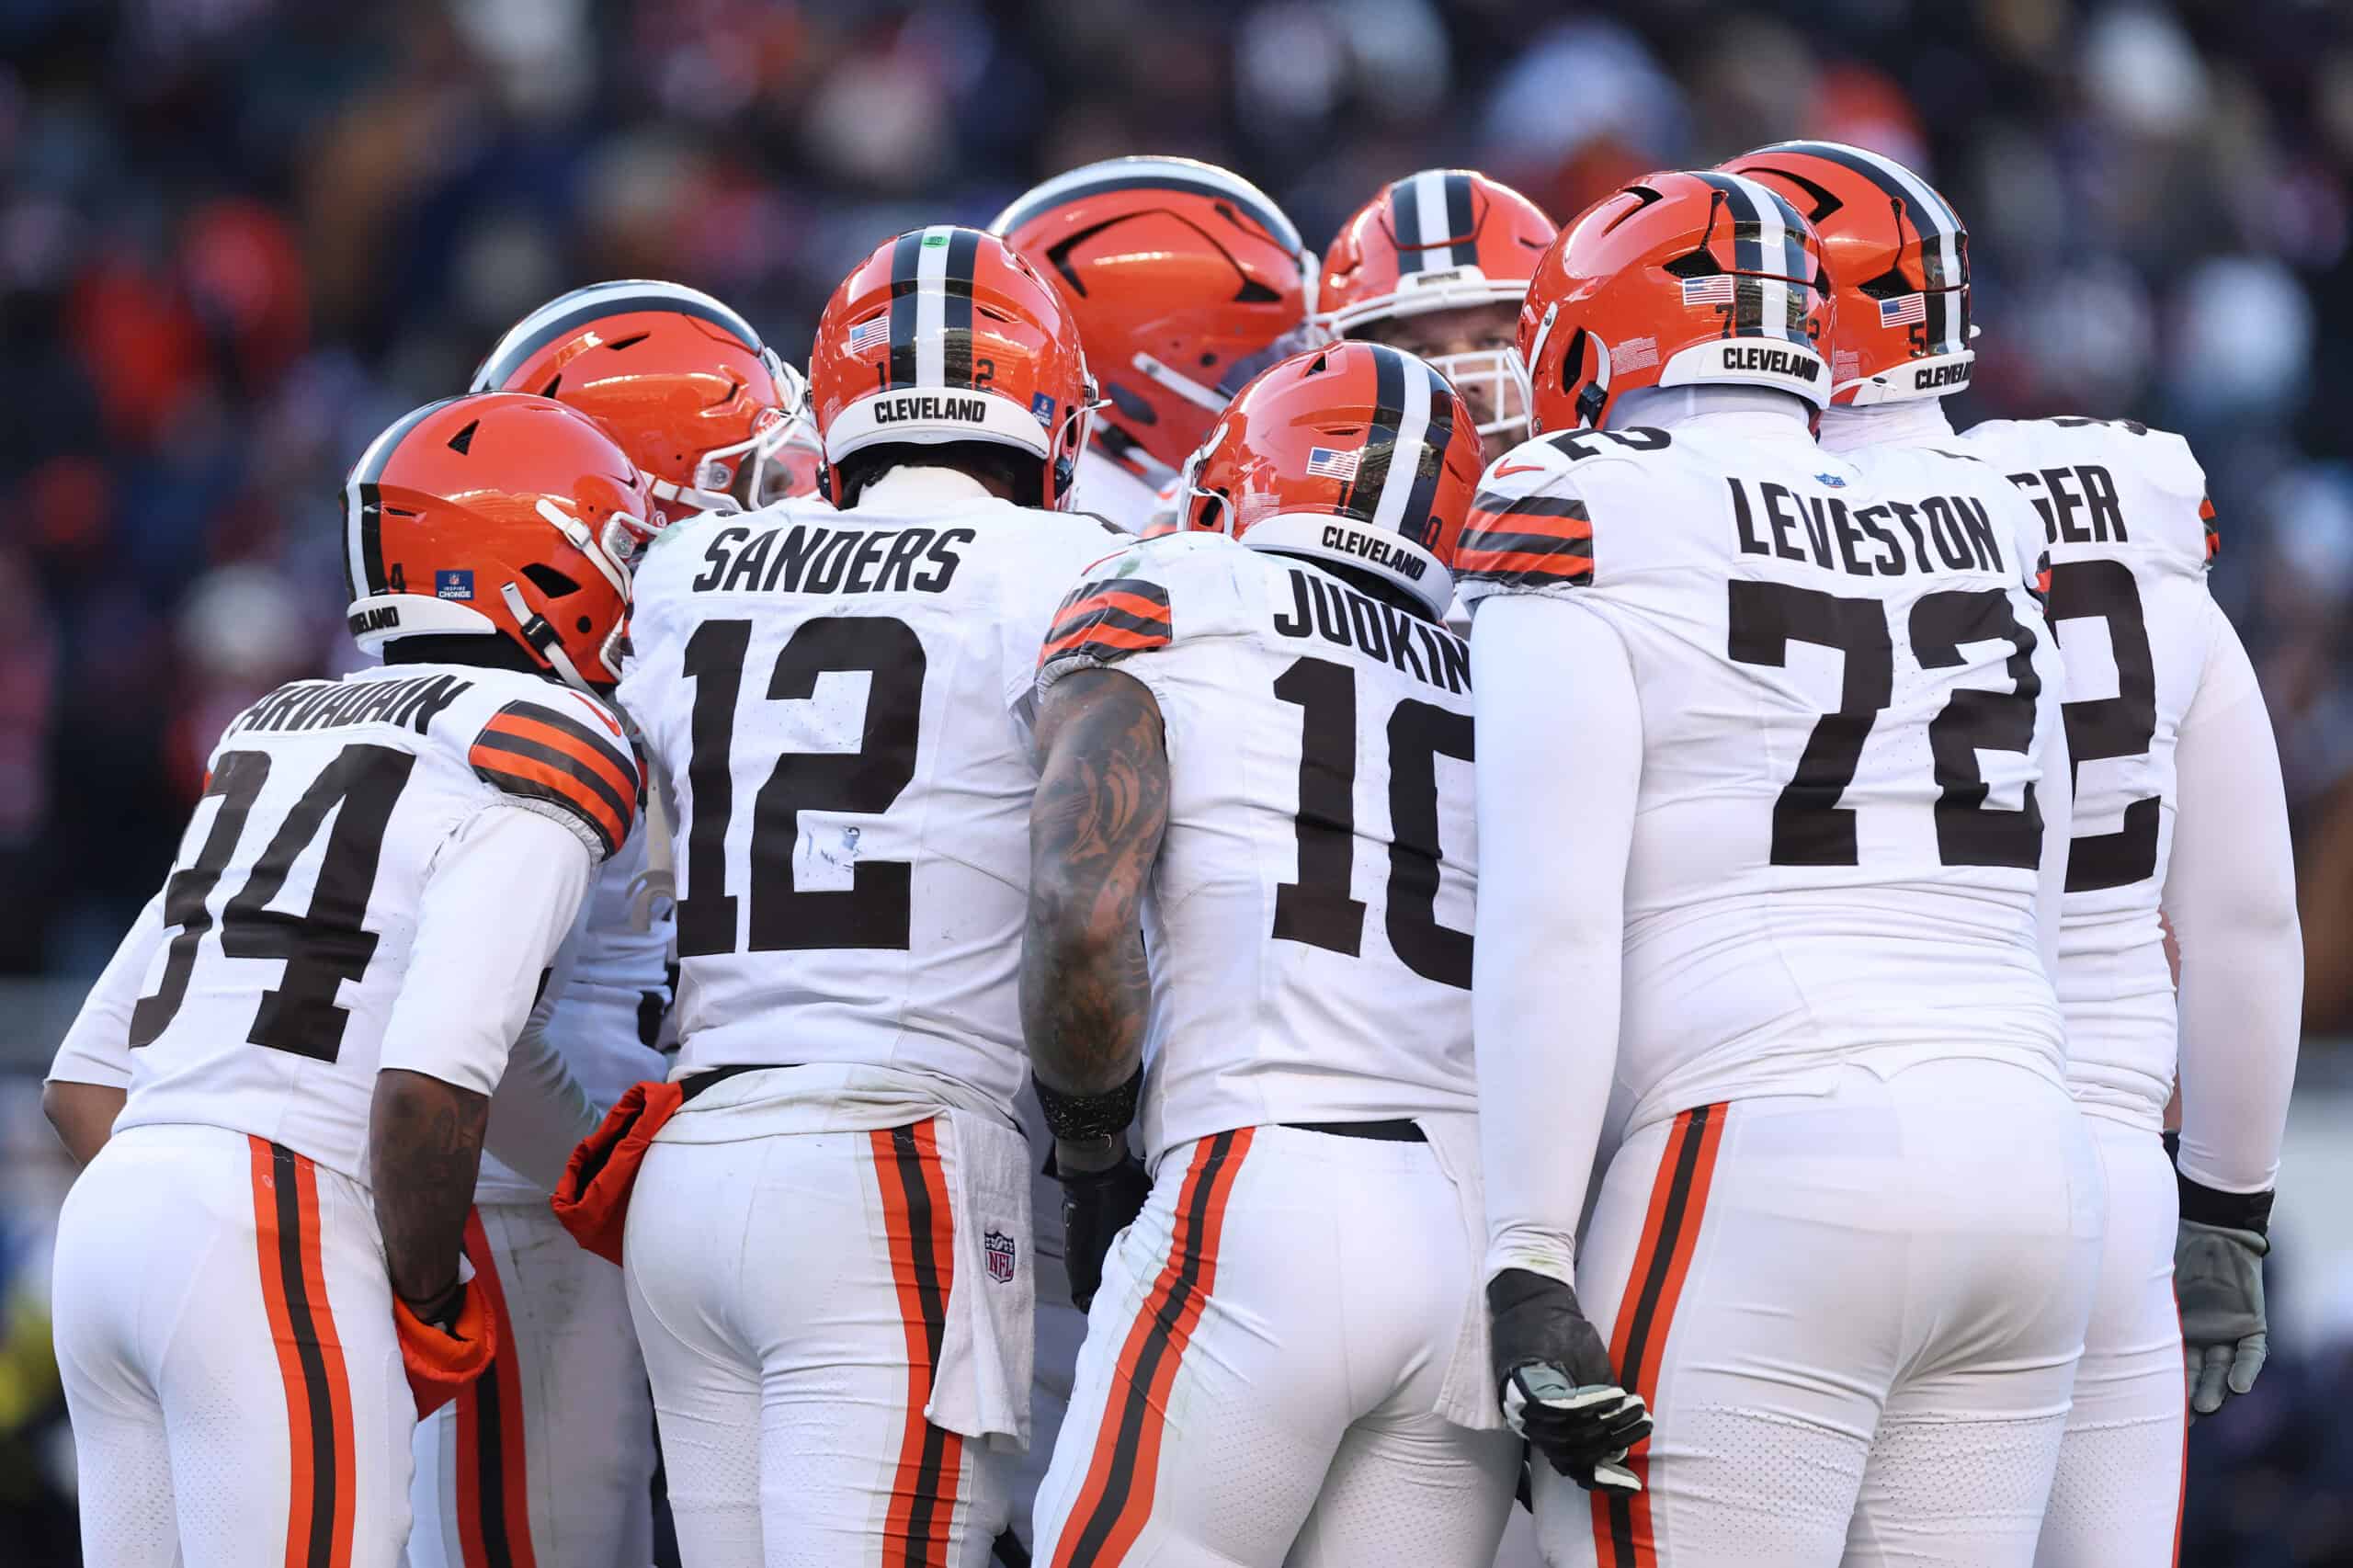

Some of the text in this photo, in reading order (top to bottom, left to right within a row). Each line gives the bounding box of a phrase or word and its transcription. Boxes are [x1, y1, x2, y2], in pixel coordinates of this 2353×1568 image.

[1715, 304, 1734, 338] 7
[974, 358, 995, 392] 2
[1722, 347, 1820, 383] CLEVELAND
[874, 397, 987, 425] CLEVELAND
[1322, 526, 1427, 581] CLEVELAND
[1727, 477, 2006, 576] LEVESTON
[391, 562, 407, 594] 4
[693, 525, 976, 594] SANDERS
[228, 675, 476, 736] ARVADAIN
[1728, 579, 2044, 870] 72
[676, 617, 926, 957] 12
